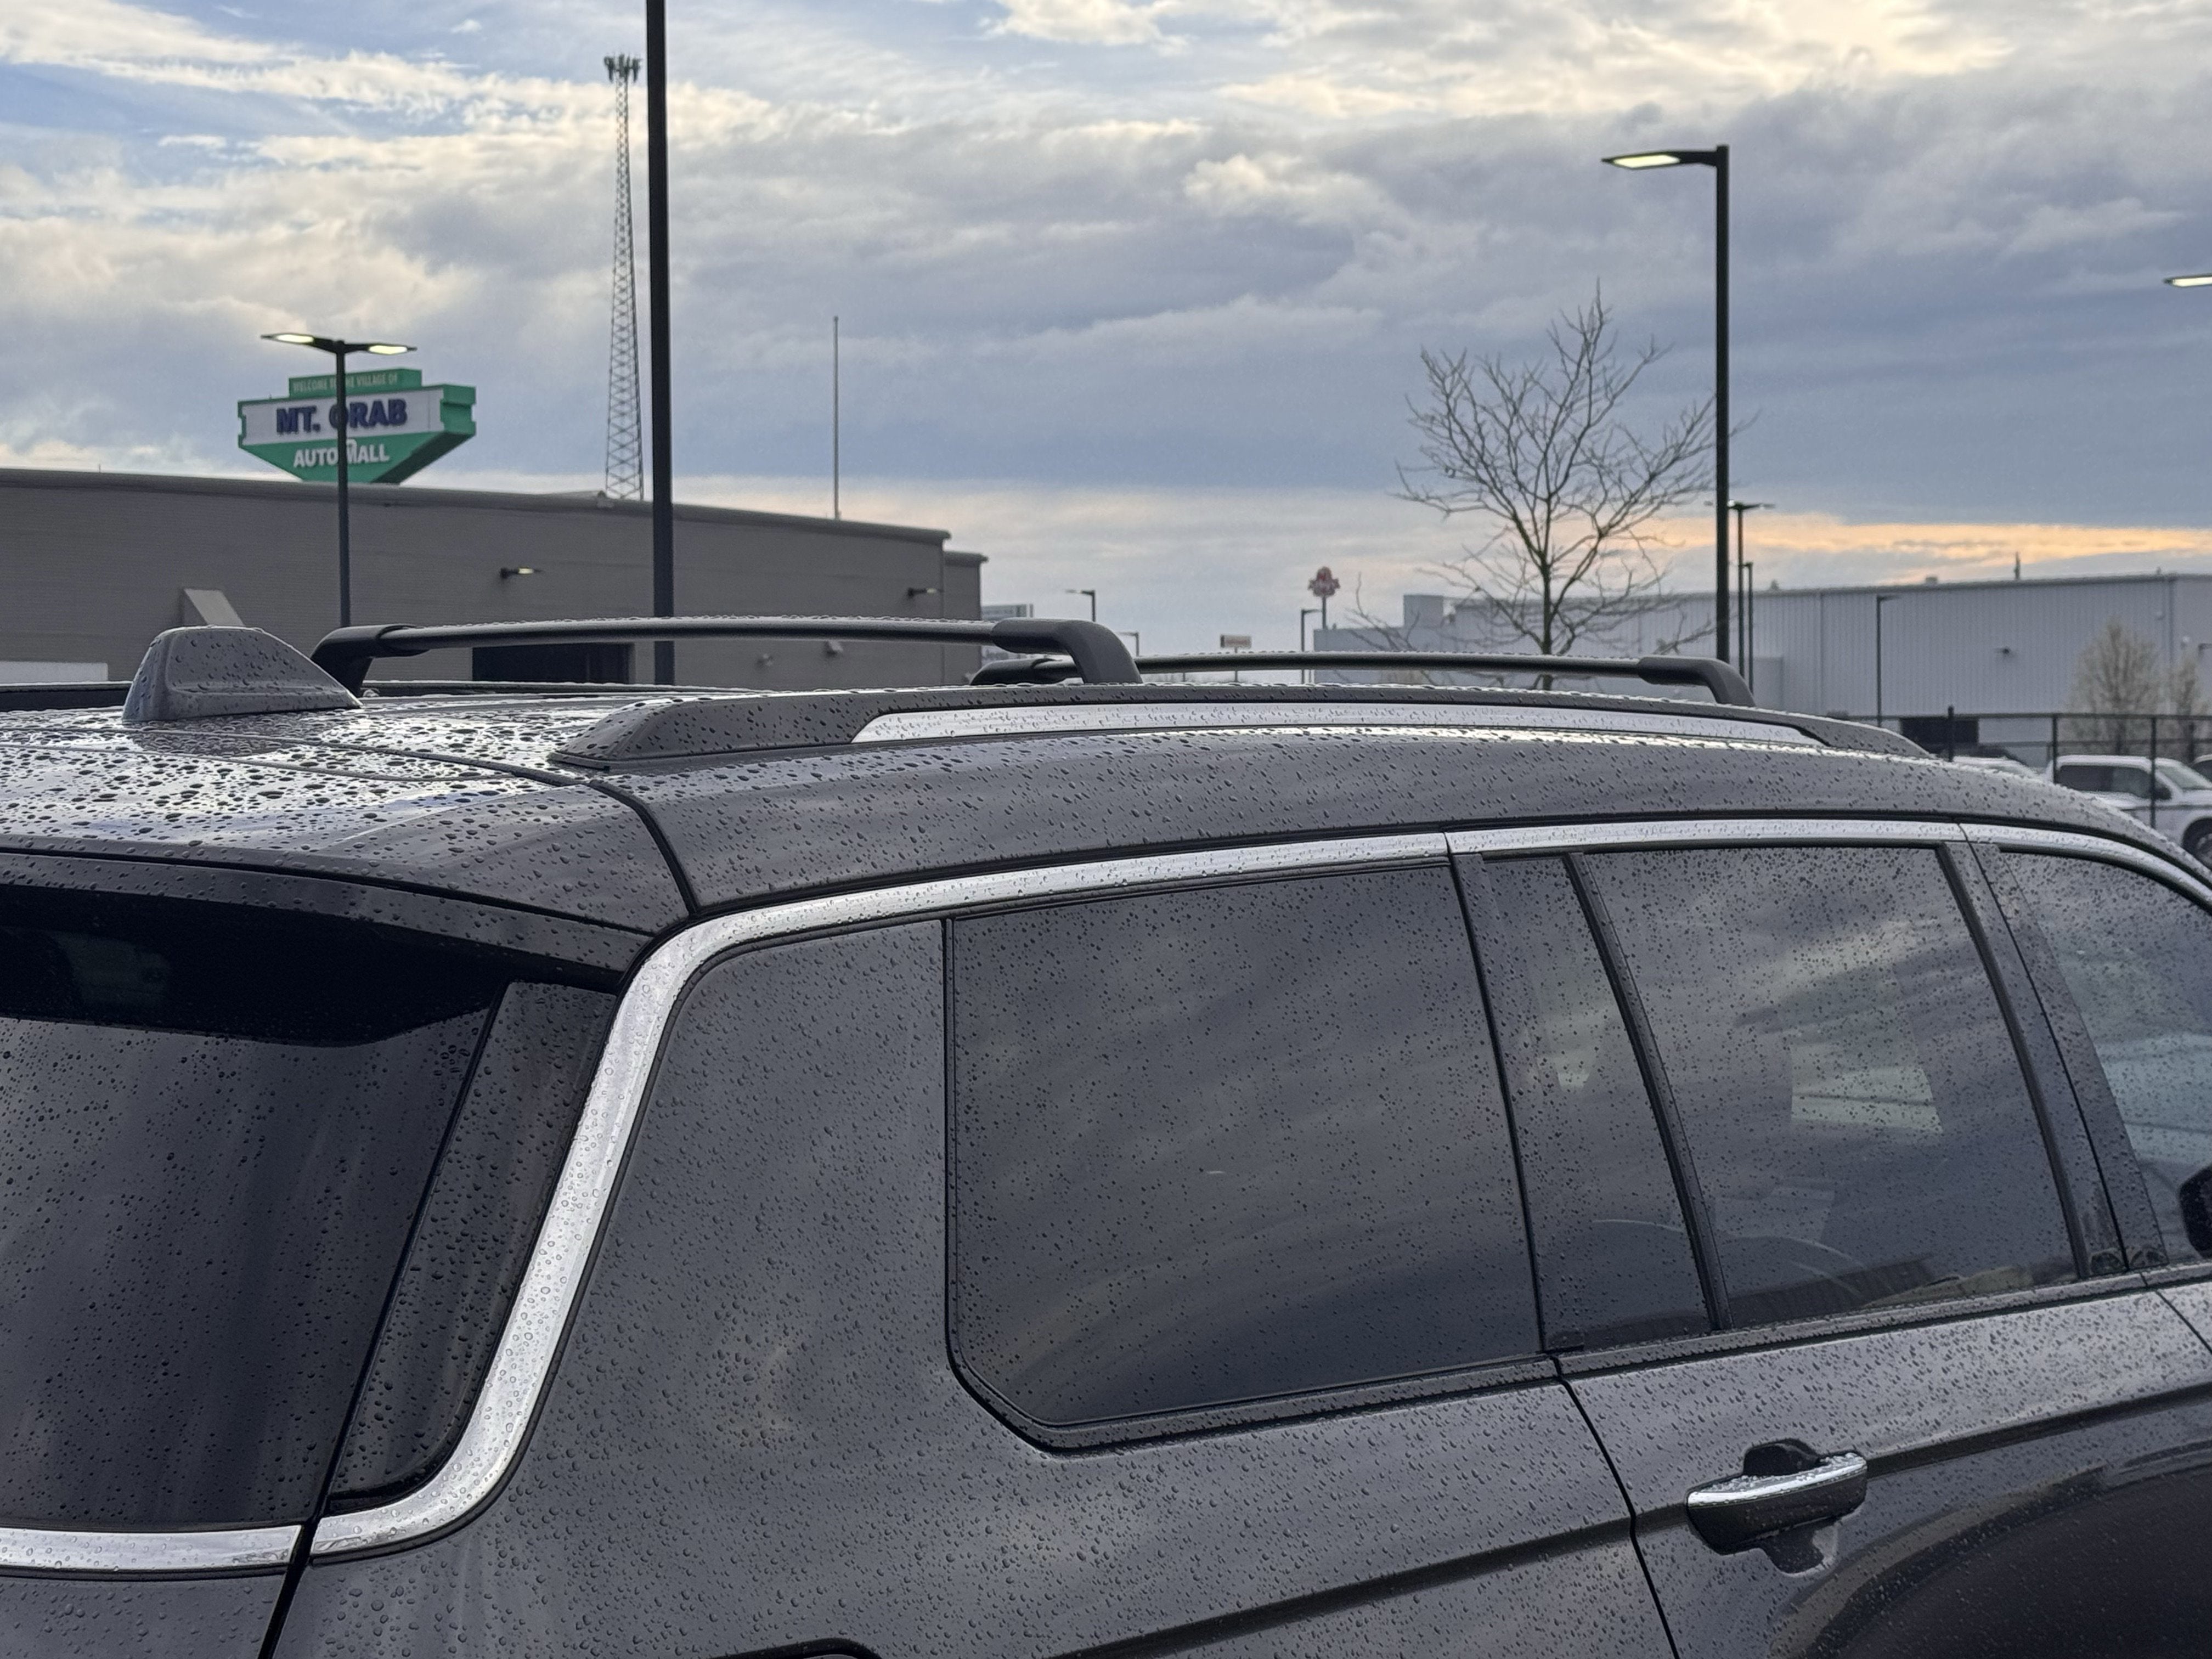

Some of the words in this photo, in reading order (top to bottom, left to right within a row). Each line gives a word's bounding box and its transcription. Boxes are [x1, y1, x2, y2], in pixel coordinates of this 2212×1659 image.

[357, 373, 385, 386] VILLAGE
[276, 405, 320, 433] MT.
[329, 399, 408, 430] ORAB
[293, 447, 338, 468] AUTO
